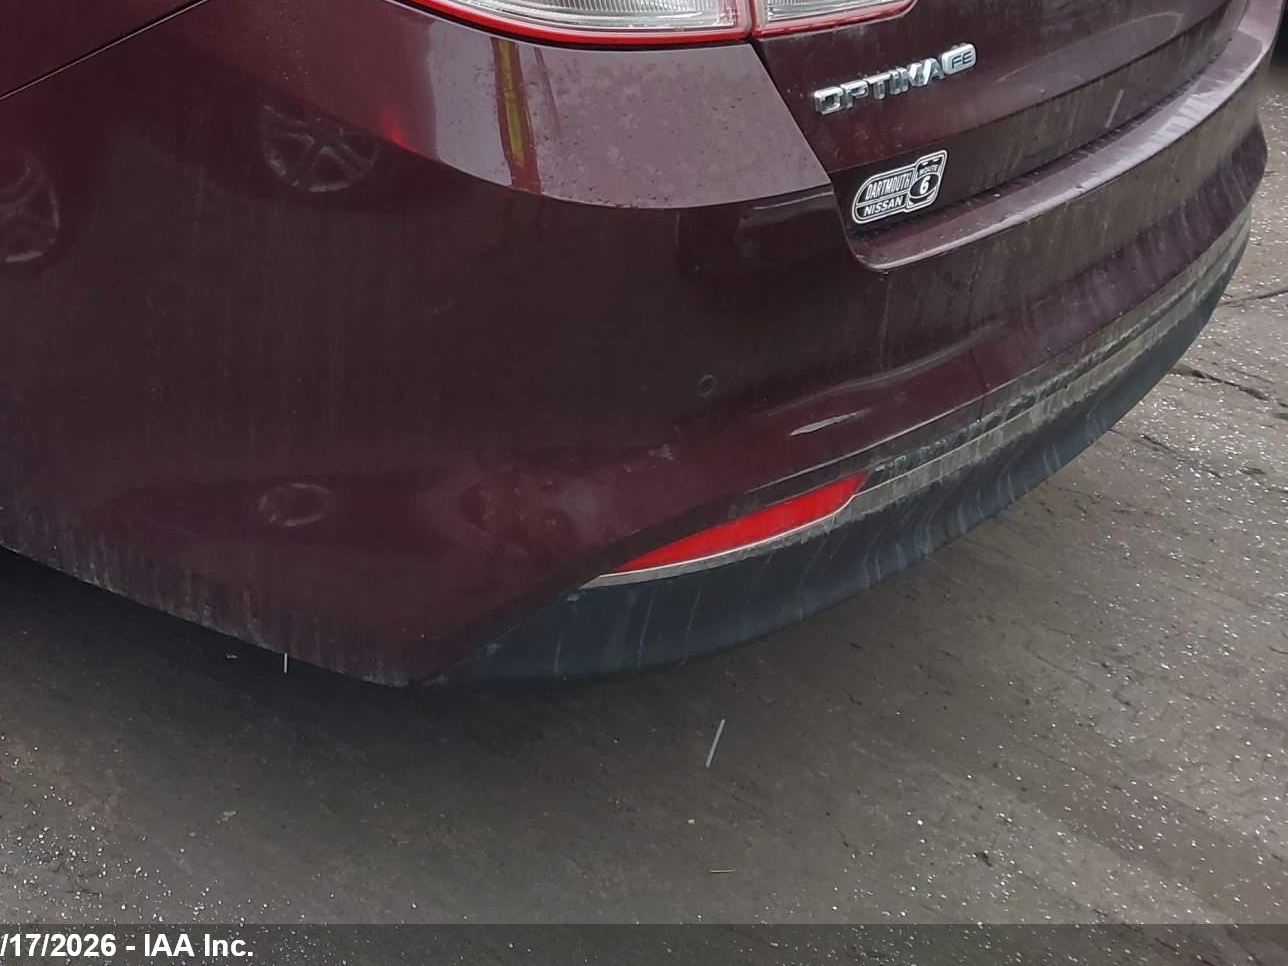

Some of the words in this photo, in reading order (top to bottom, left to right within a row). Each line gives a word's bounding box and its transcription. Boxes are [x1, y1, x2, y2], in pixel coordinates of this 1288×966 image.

[814, 57, 945, 115] OPTIMA
[865, 173, 912, 201] DARTMOUTH
[919, 175, 932, 195] 6
[863, 195, 904, 217] NISSAN
